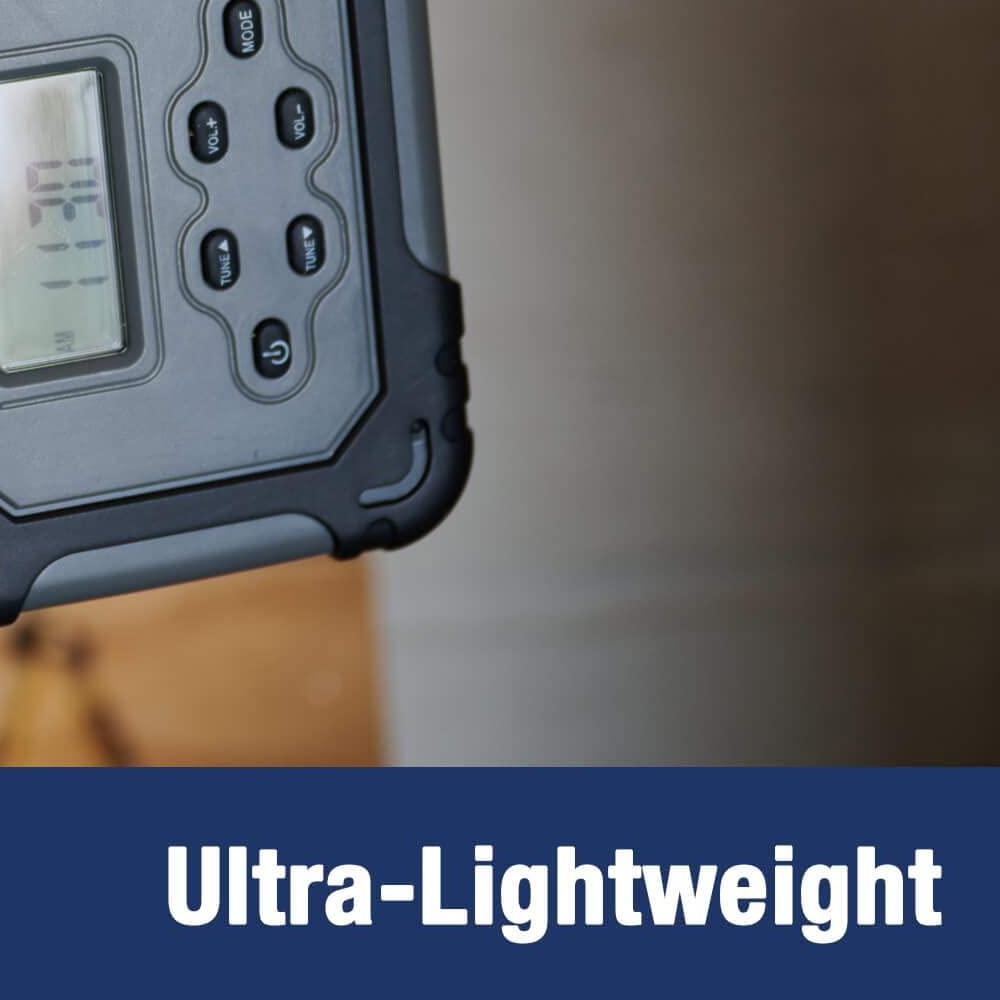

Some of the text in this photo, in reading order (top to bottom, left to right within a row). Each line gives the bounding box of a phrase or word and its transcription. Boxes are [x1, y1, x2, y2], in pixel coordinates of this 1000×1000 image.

[239, 9, 254, 53] MODE
[219, 252, 232, 286] TUNE
[303, 238, 317, 272] TUNE
[54, 330, 74, 351] AM
